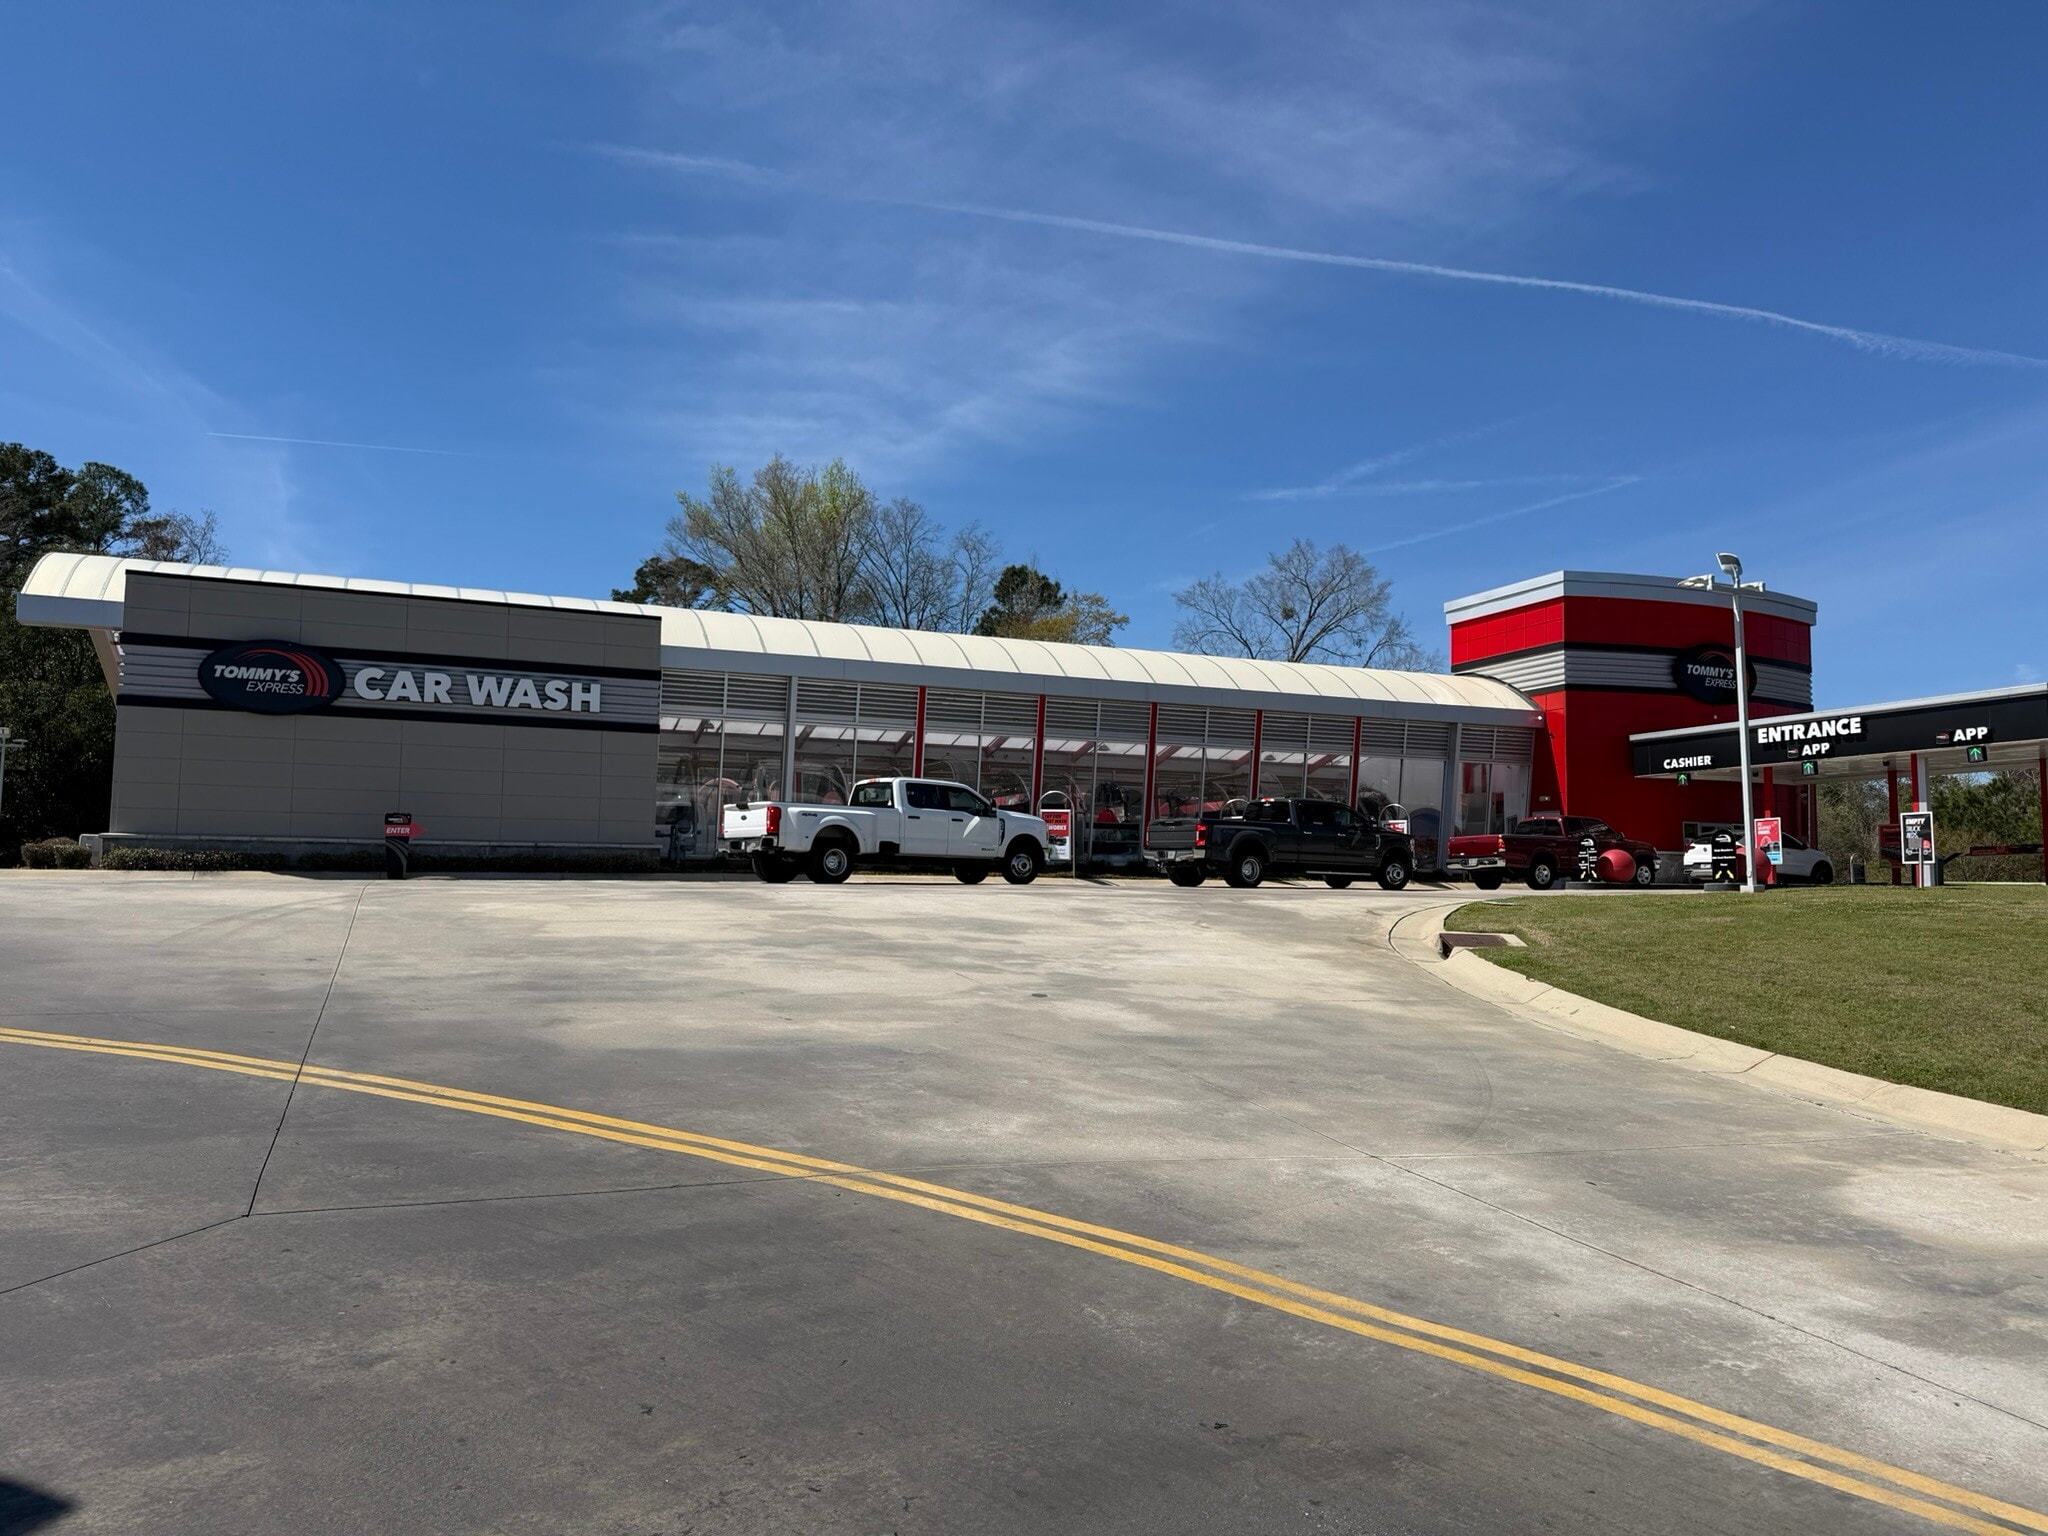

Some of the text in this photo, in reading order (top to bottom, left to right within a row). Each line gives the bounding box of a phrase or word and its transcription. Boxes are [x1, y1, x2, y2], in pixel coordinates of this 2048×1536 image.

[214, 665, 301, 682] TOMMY'S
[1687, 664, 1734, 679] TOMMY'S
[246, 681, 305, 695] EXPRESS
[354, 667, 601, 713] CAR WASH
[1705, 677, 1737, 689] EXPRESS
[1757, 717, 1862, 744] ENTRANCE
[1953, 726, 1988, 742] APP
[1801, 742, 1830, 756] APP
[1663, 755, 1712, 769] CASHIER
